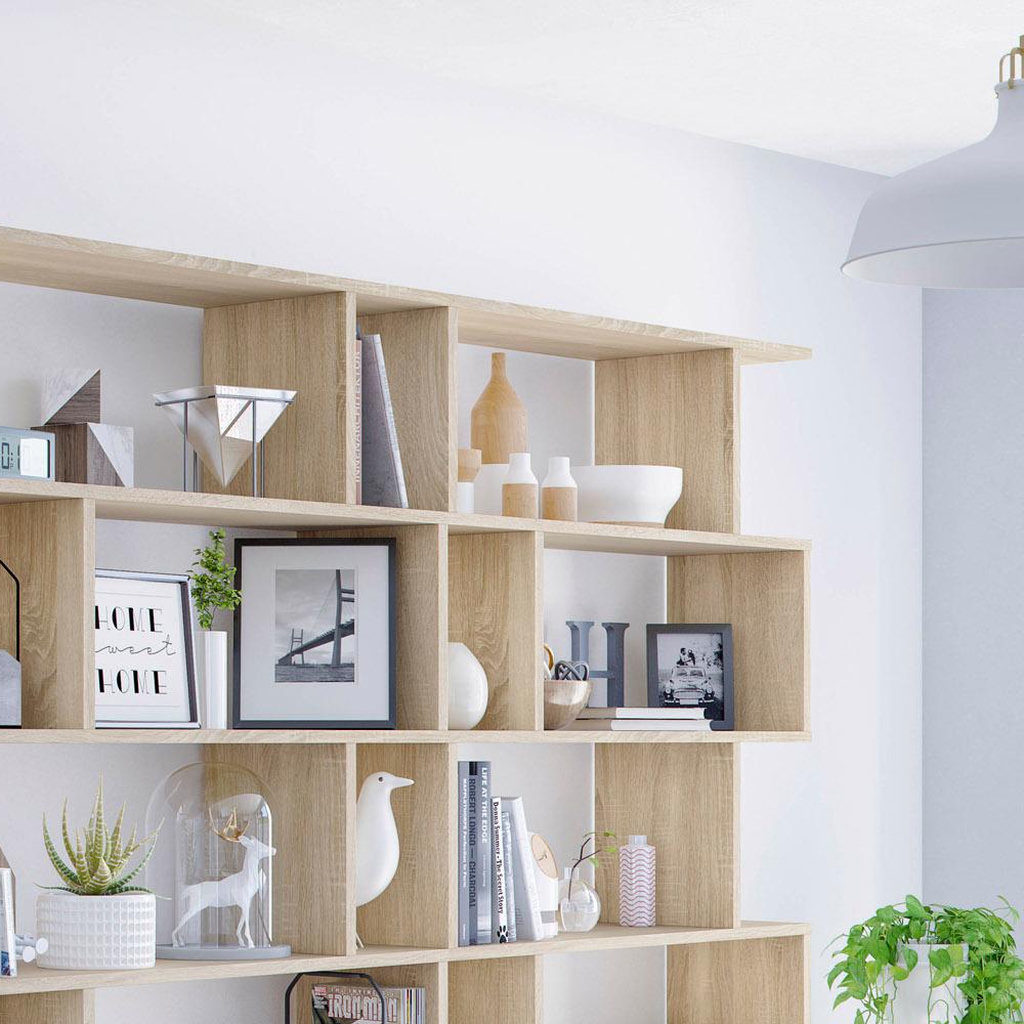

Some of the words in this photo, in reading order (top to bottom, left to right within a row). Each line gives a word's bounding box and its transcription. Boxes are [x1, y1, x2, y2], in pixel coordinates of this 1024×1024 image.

[95, 605, 162, 633] HOME
[95, 634, 176, 656] weet
[96, 668, 168, 695] HOME
[481, 788, 488, 798] AT
